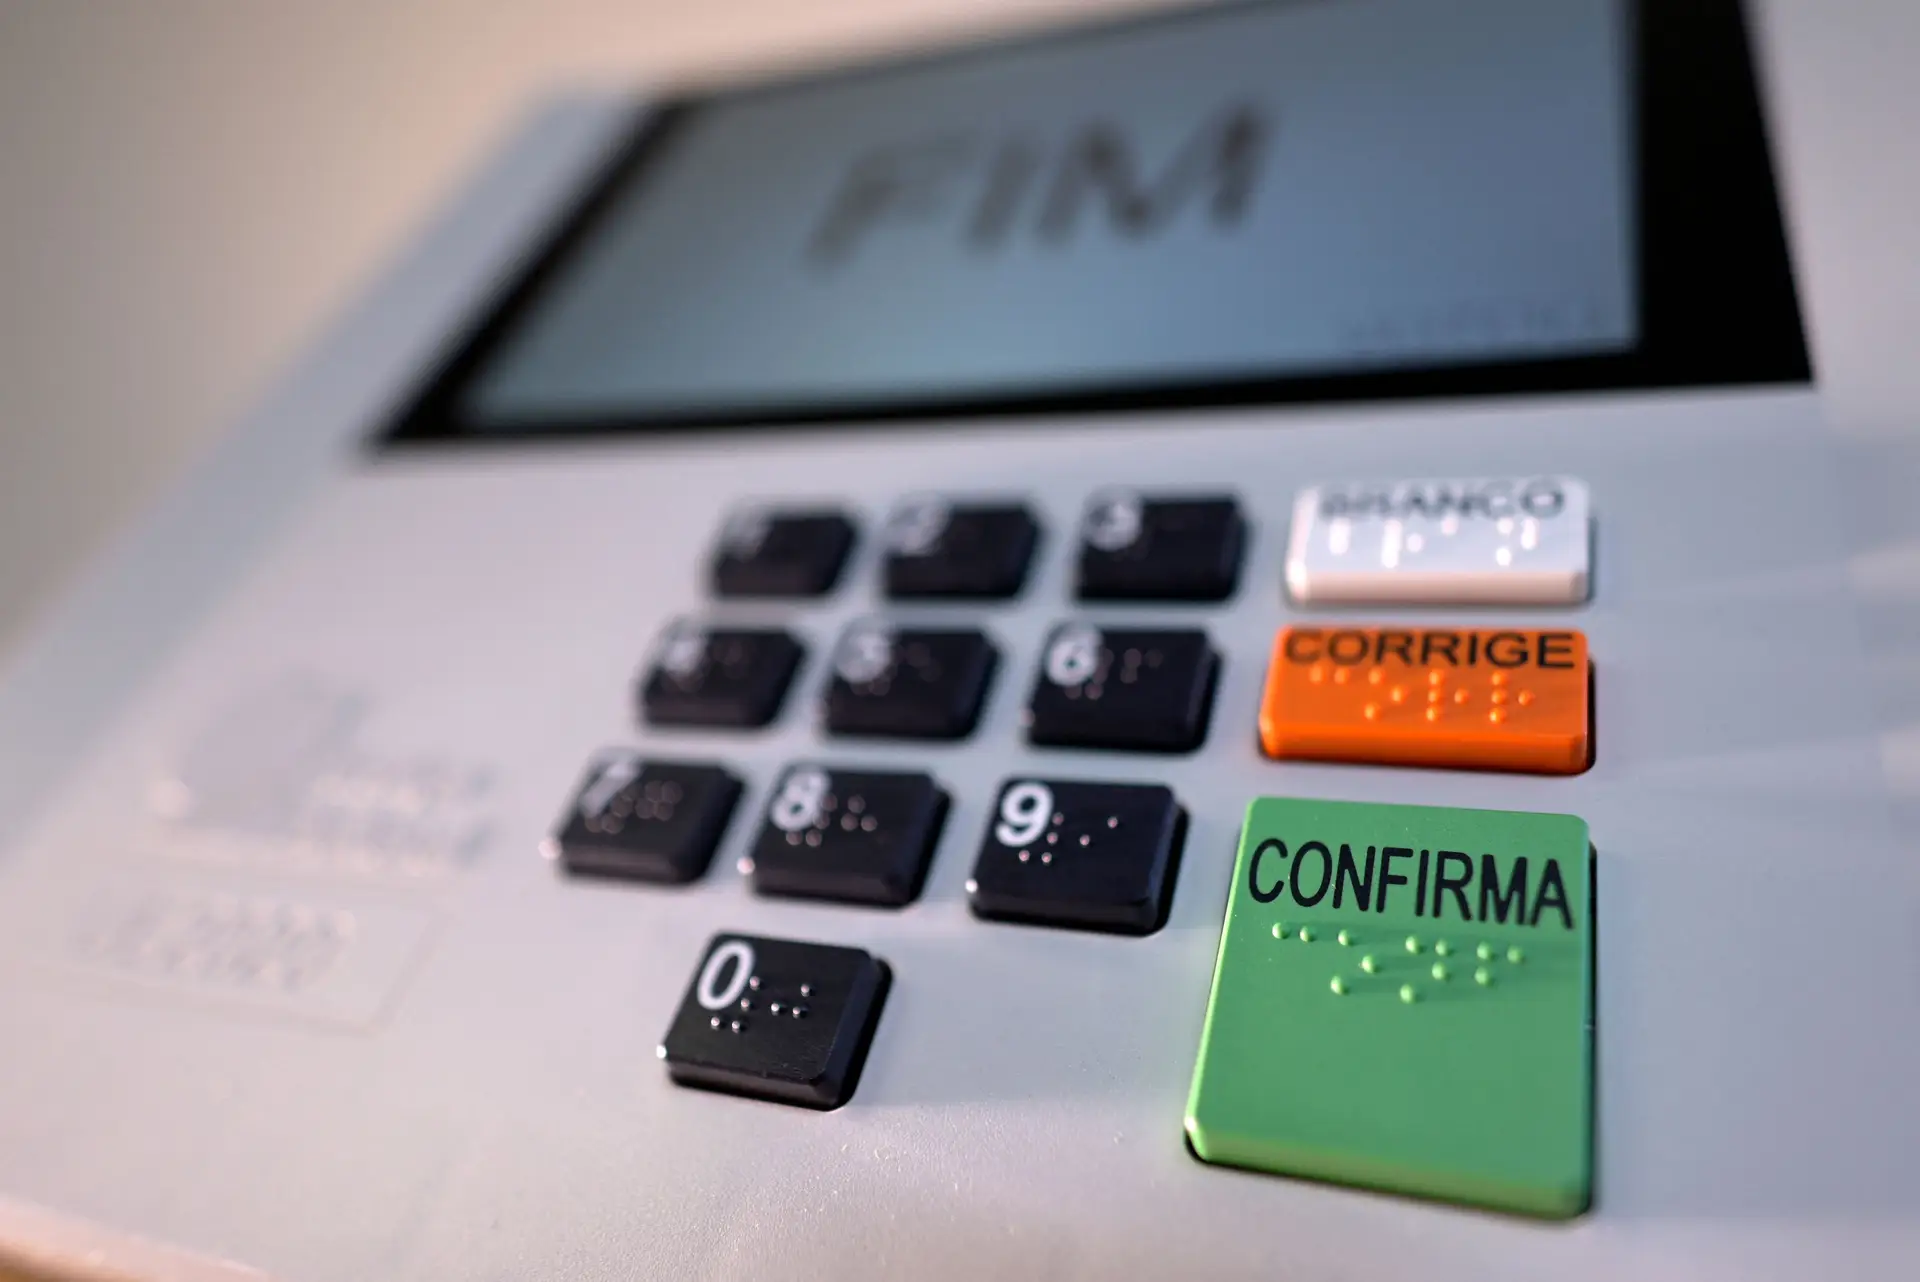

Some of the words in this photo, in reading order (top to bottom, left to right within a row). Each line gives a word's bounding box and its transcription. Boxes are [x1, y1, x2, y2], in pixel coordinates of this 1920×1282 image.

[812, 96, 1274, 268] FIM
[1085, 488, 1141, 550] 3
[1046, 624, 1102, 687] 6
[1285, 629, 1576, 669] CORRIGE
[770, 764, 831, 832] 8
[996, 782, 1054, 848] 9
[1248, 837, 1576, 930] CONFIRMA
[696, 940, 755, 1011] 0
